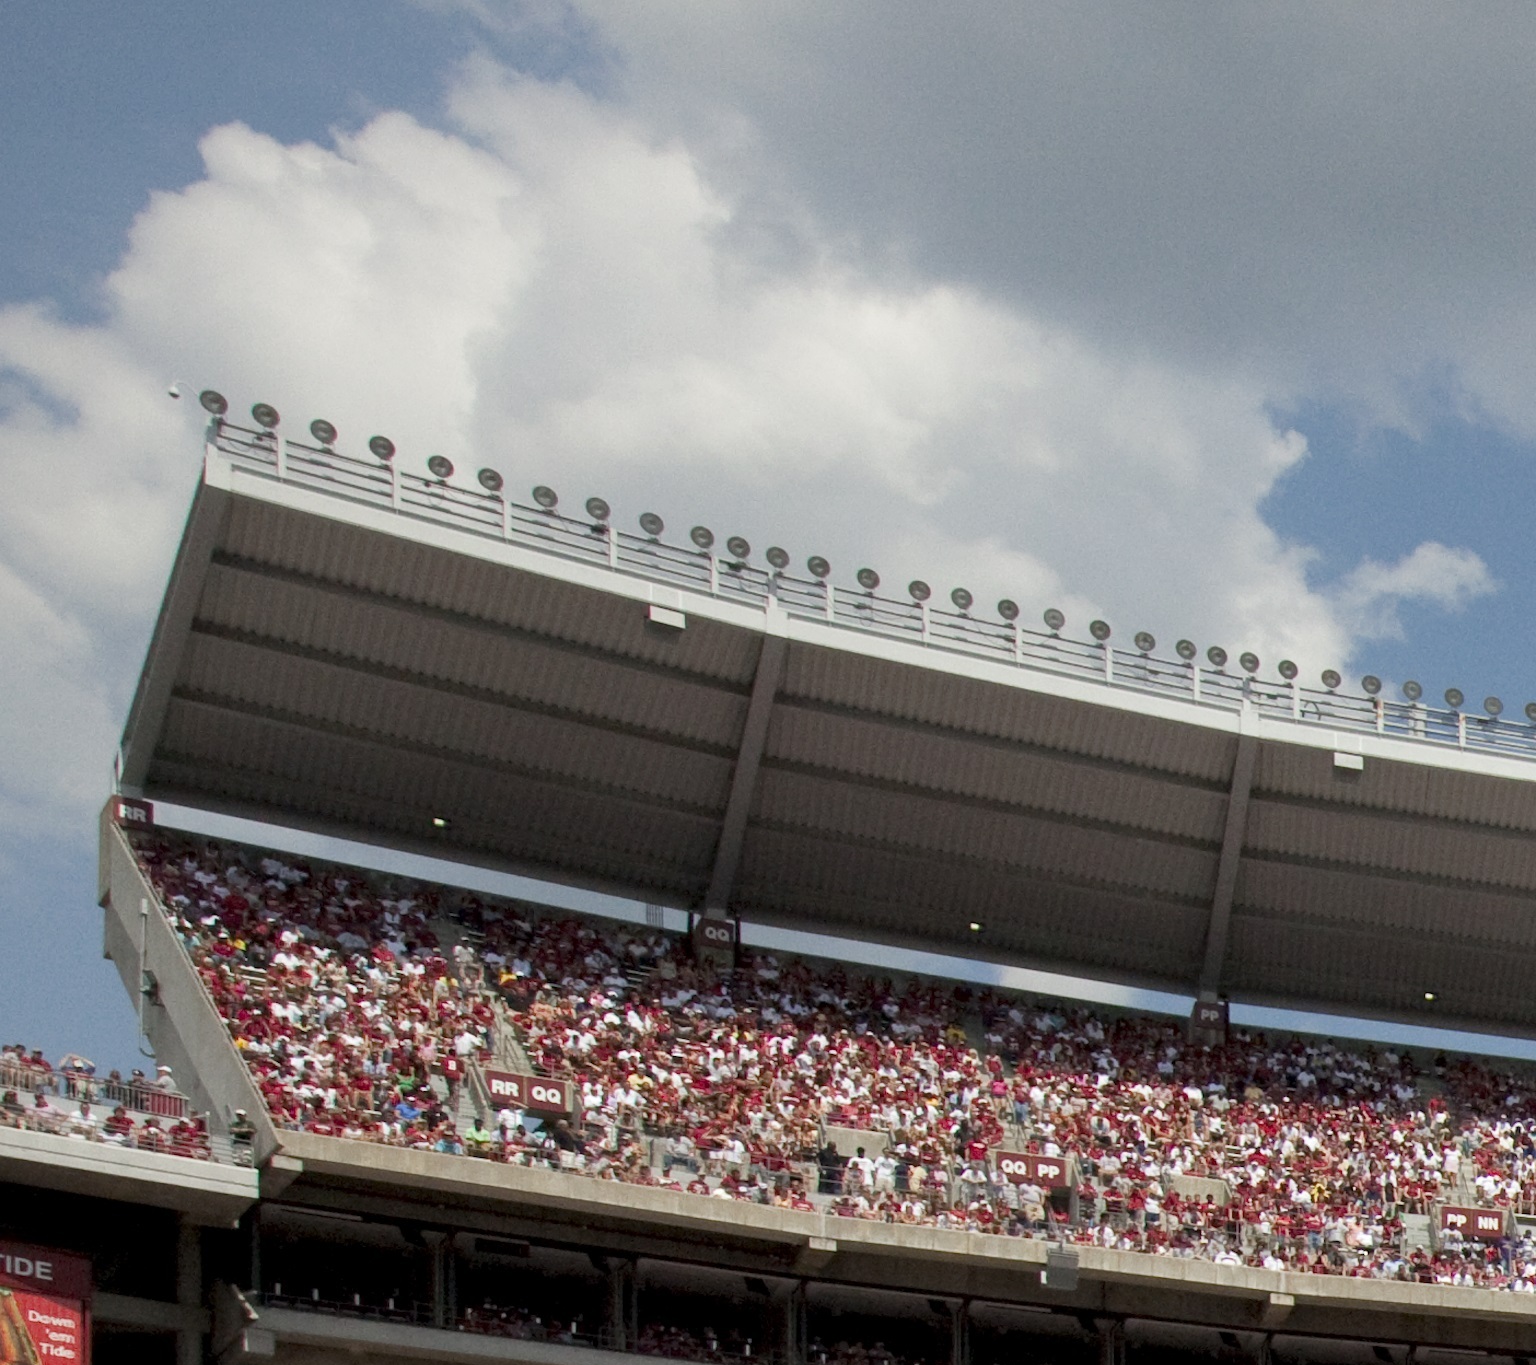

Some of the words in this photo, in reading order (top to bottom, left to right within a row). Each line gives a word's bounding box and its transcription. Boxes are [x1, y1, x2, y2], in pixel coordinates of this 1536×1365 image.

[119, 804, 147, 822] RR
[705, 926, 730, 942] QQ
[1200, 1008, 1219, 1021] PP
[491, 1078, 519, 1097] RR
[531, 1085, 561, 1104] QQ
[1001, 1159, 1027, 1176] QQ
[1037, 1162, 1060, 1179] PP
[1478, 1215, 1499, 1230] NN
[28, 1309, 75, 1329] Down
[39, 1343, 75, 1359] Tide
